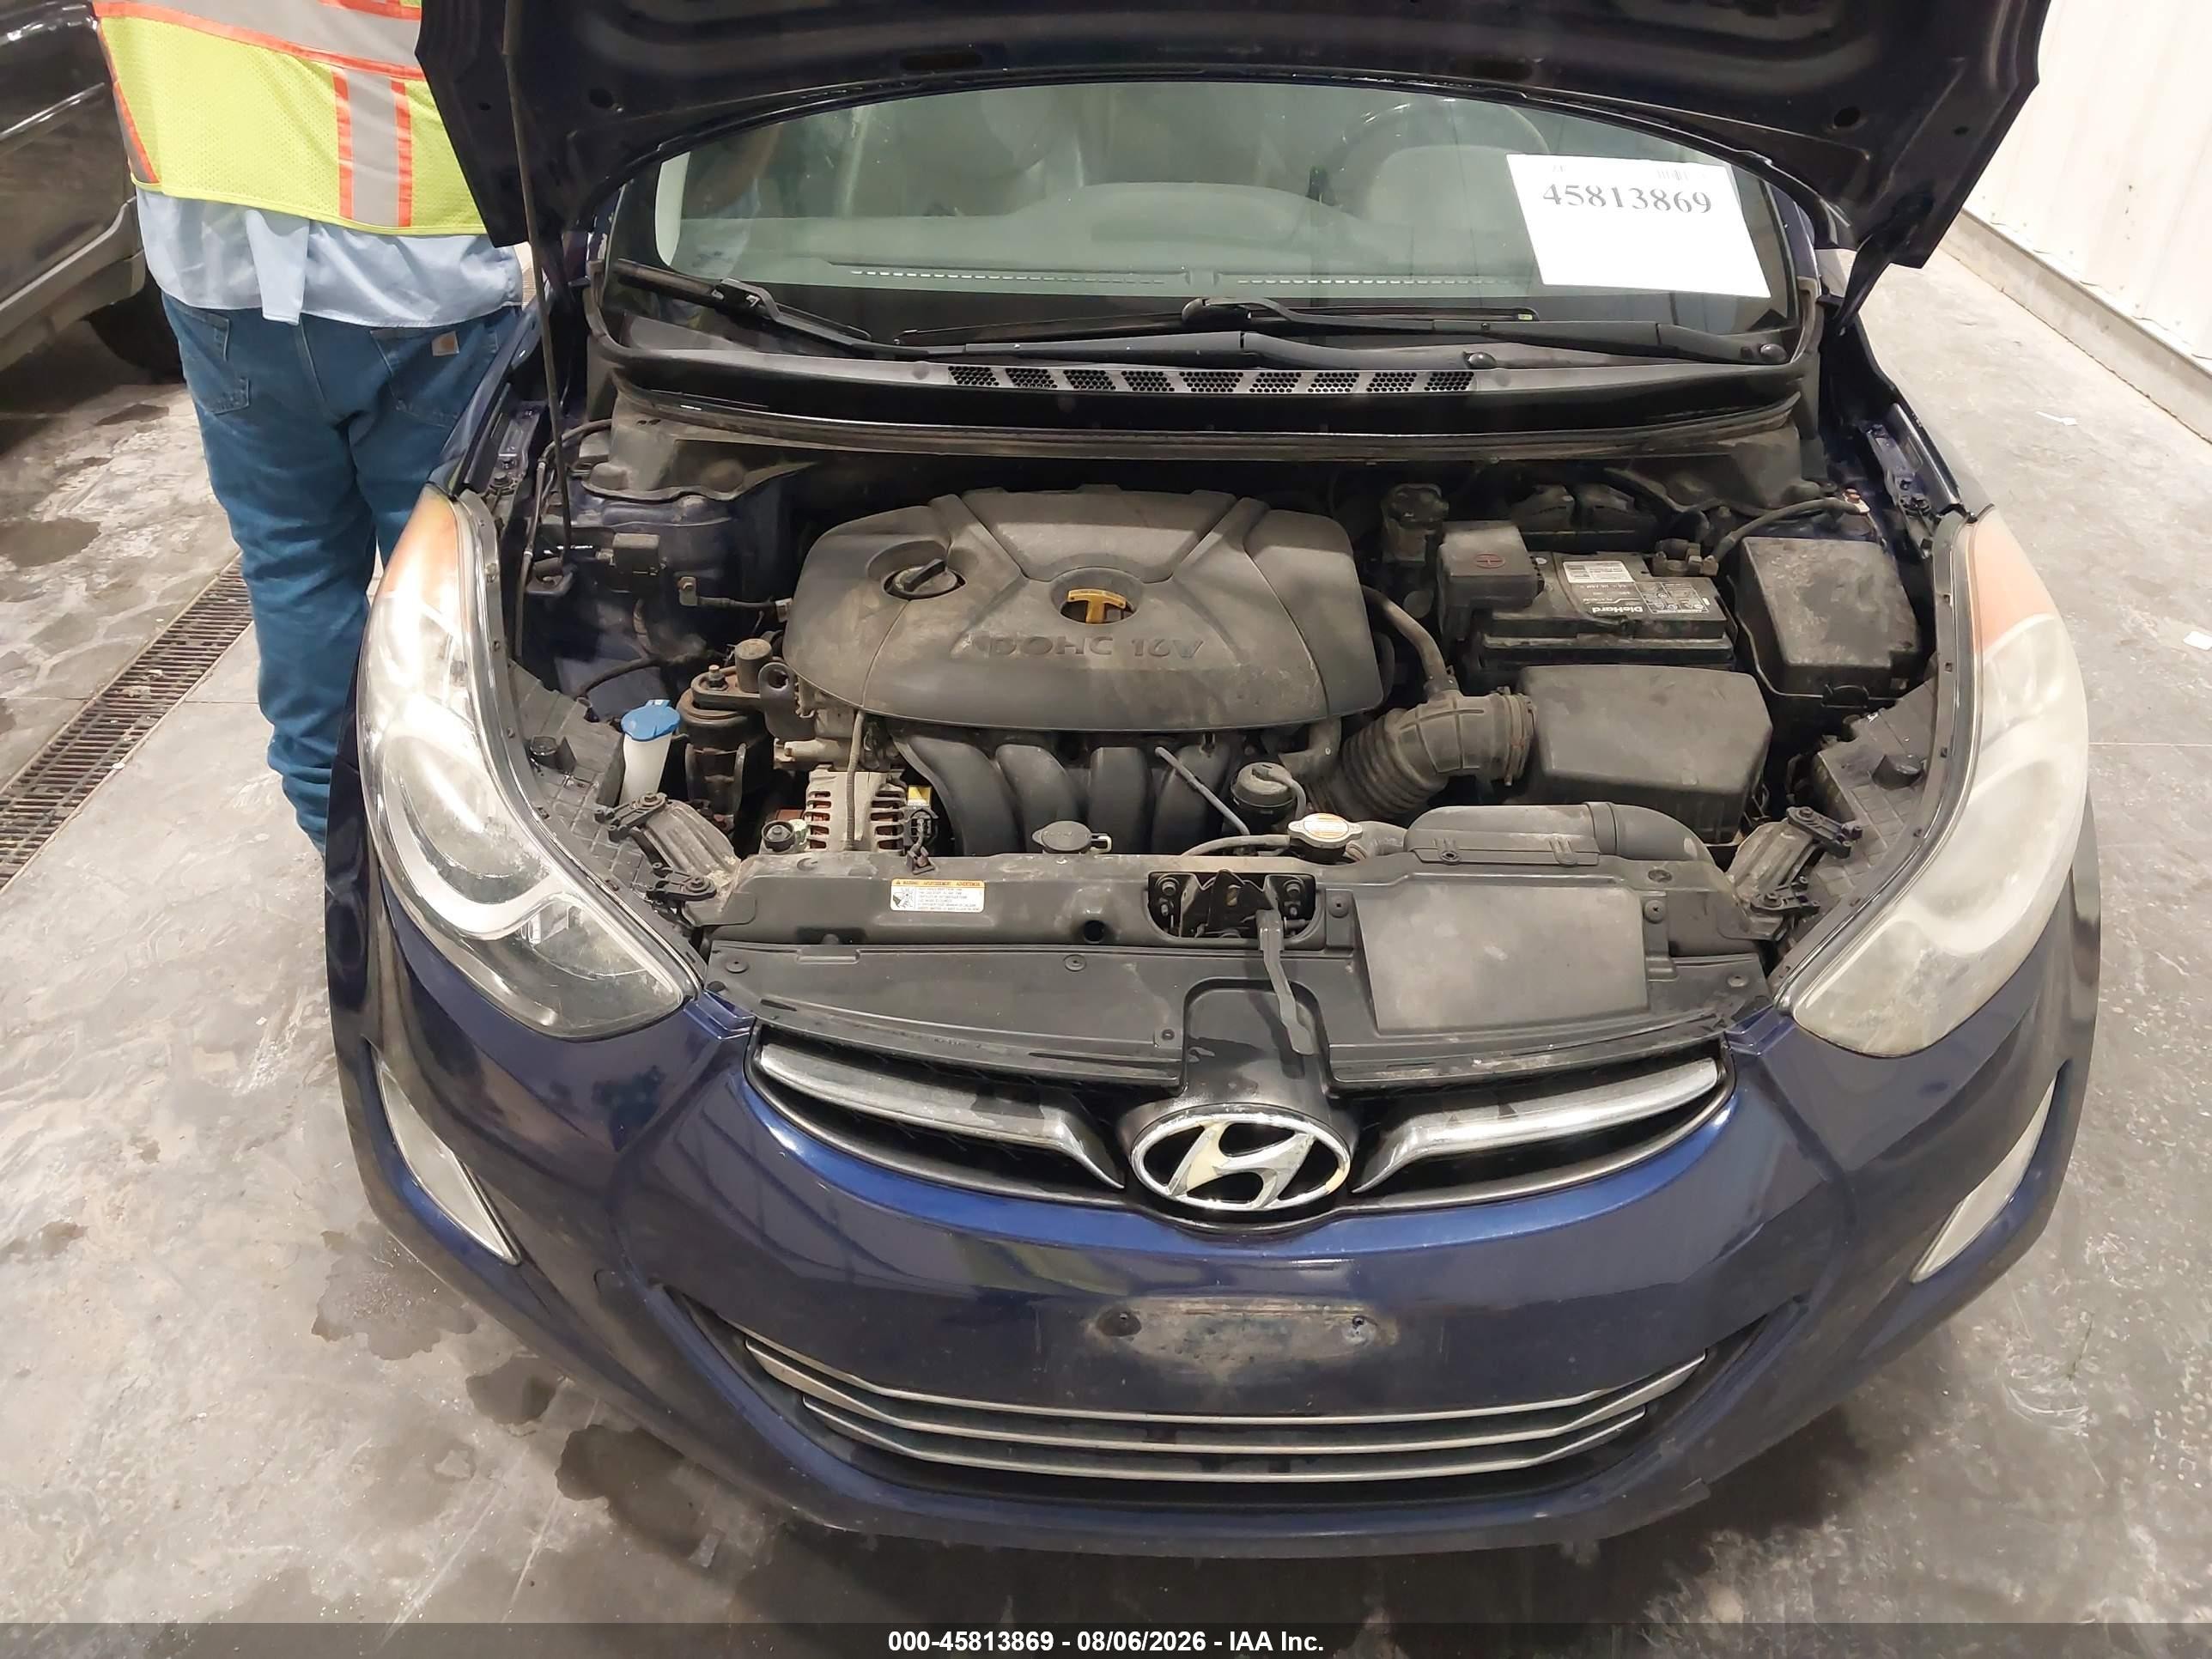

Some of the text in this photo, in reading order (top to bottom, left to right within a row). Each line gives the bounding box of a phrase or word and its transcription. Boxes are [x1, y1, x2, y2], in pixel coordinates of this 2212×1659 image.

[1542, 183, 1711, 214] 45813869
[1591, 605, 1644, 614] DieHard
[988, 636, 1204, 659] DOHC 16V
